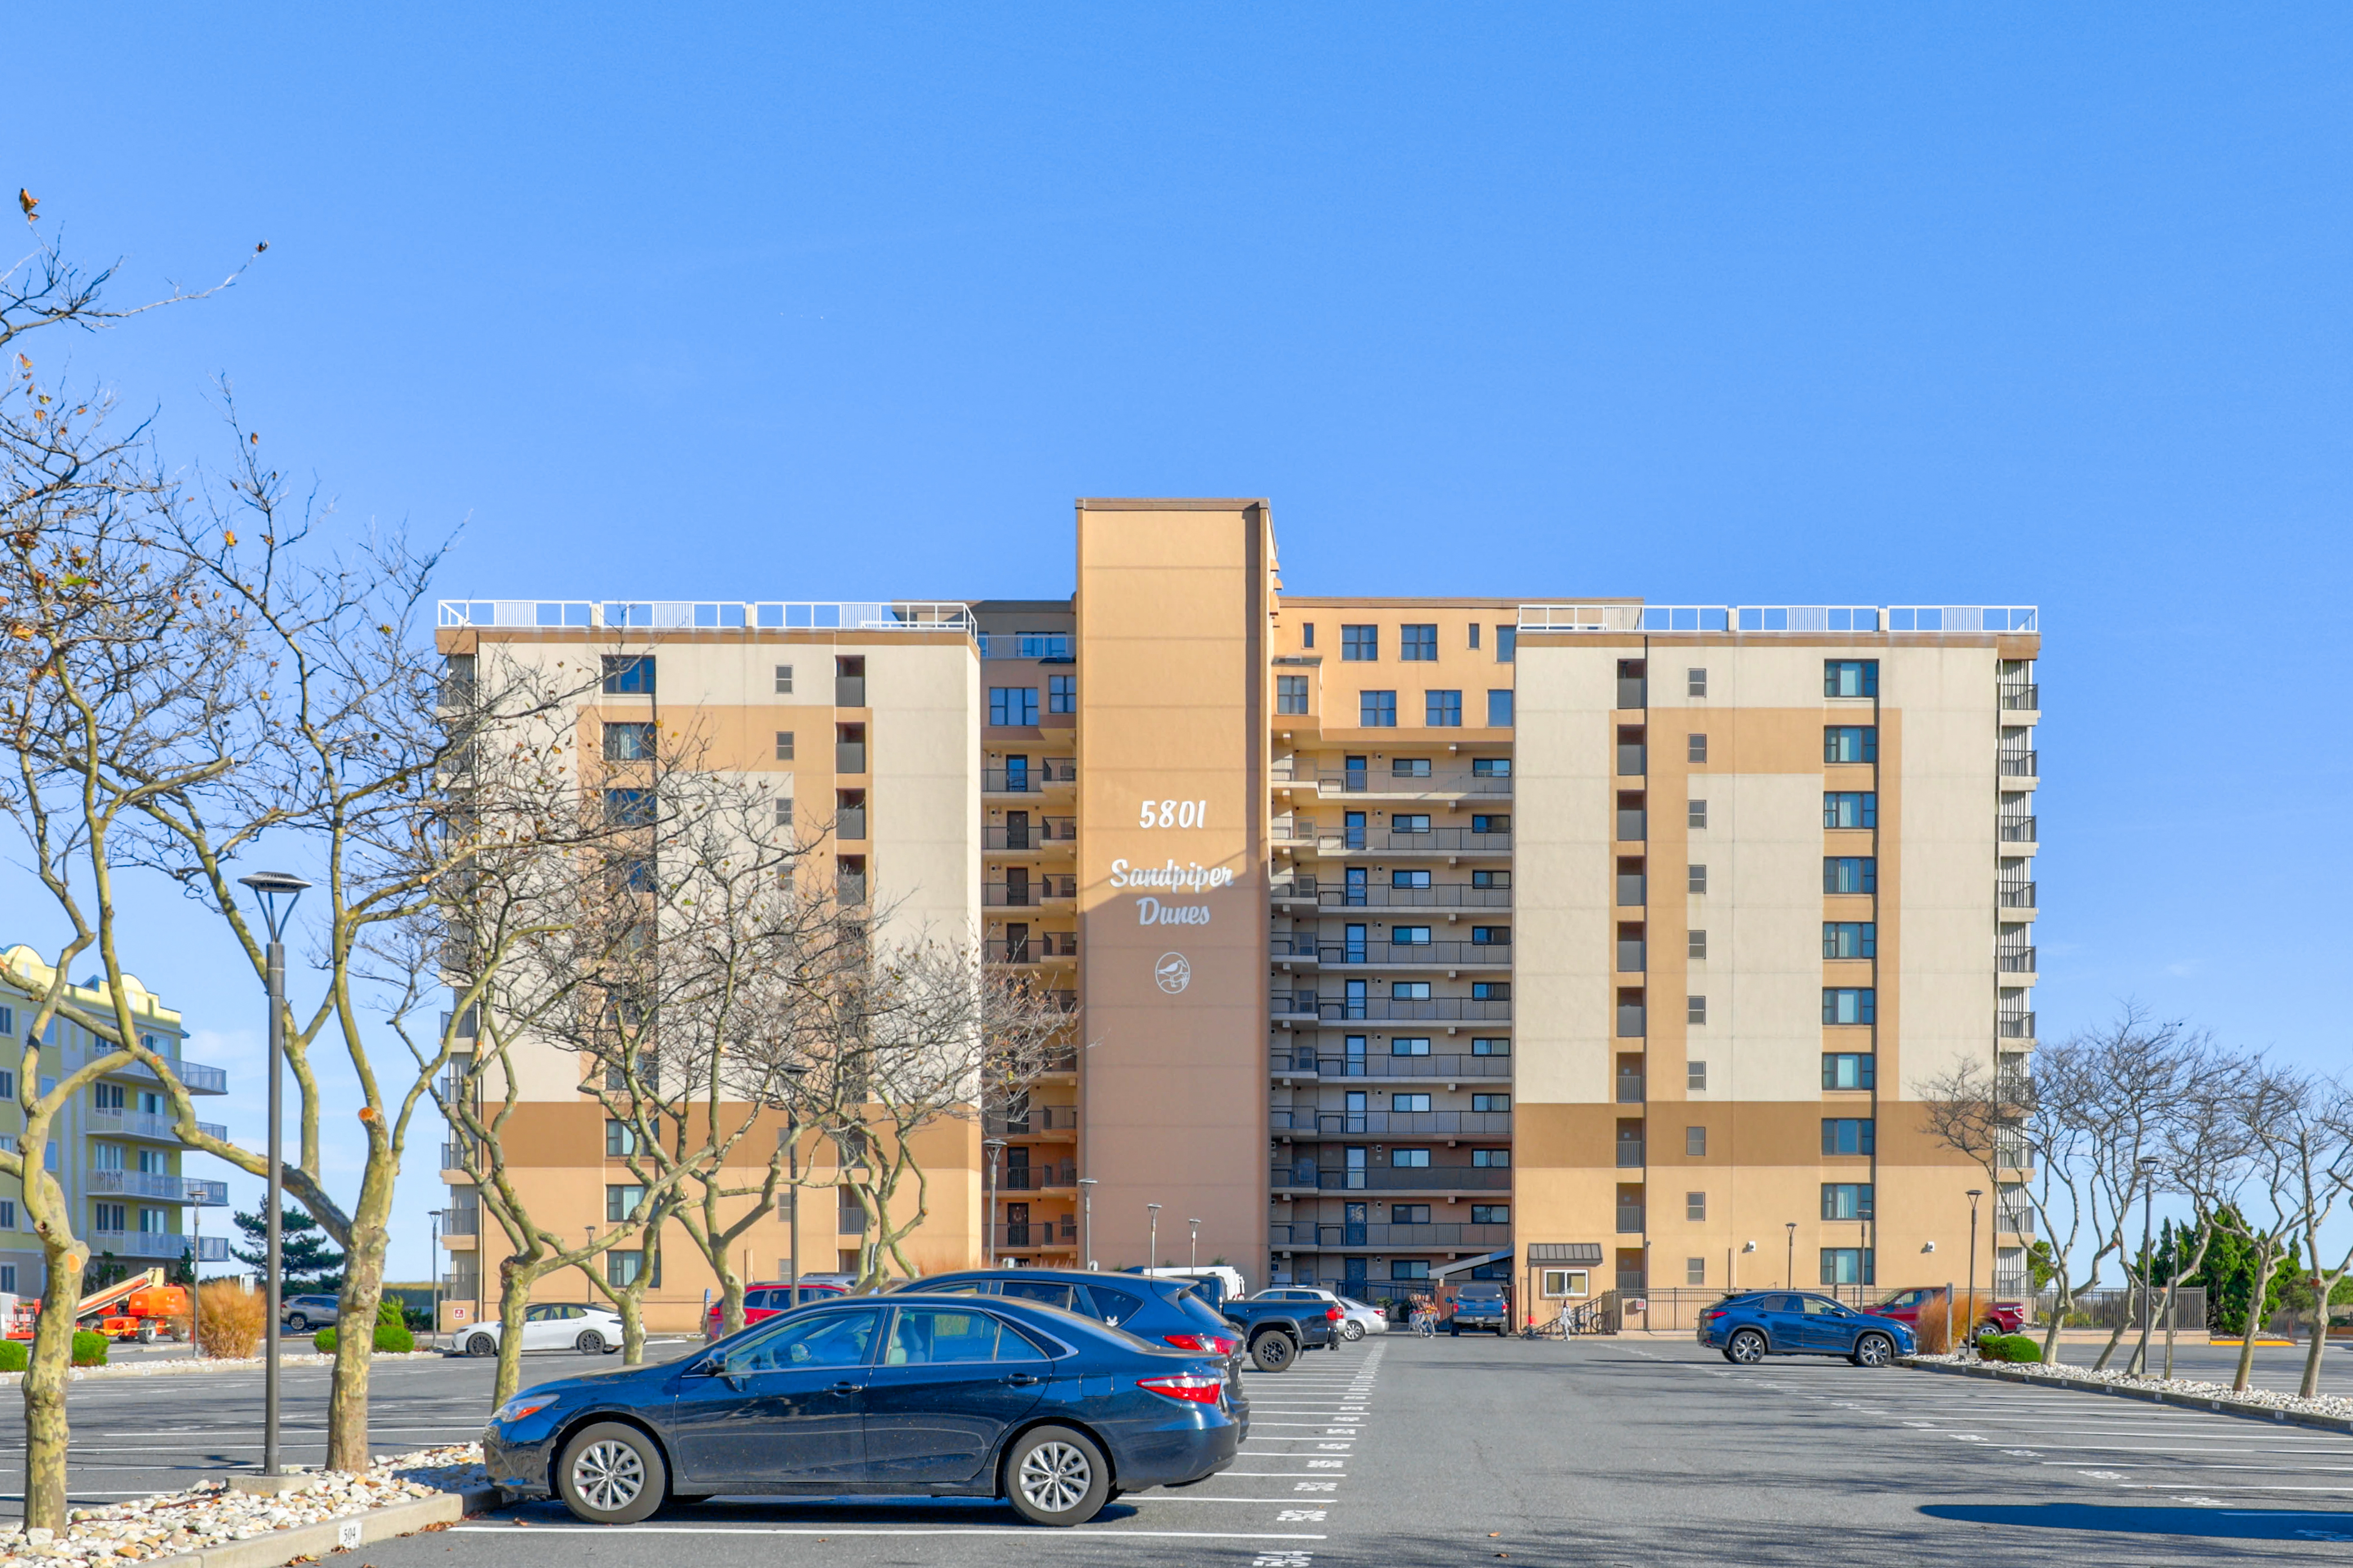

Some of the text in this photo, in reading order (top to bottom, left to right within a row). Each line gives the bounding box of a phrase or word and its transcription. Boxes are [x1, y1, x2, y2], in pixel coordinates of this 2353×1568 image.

[1139, 800, 1207, 828] 5801
[1109, 859, 1234, 893] Sandpiper
[1136, 897, 1211, 925] Dunes
[344, 1527, 356, 1542] 504
[1252, 1550, 1314, 1567] 504
